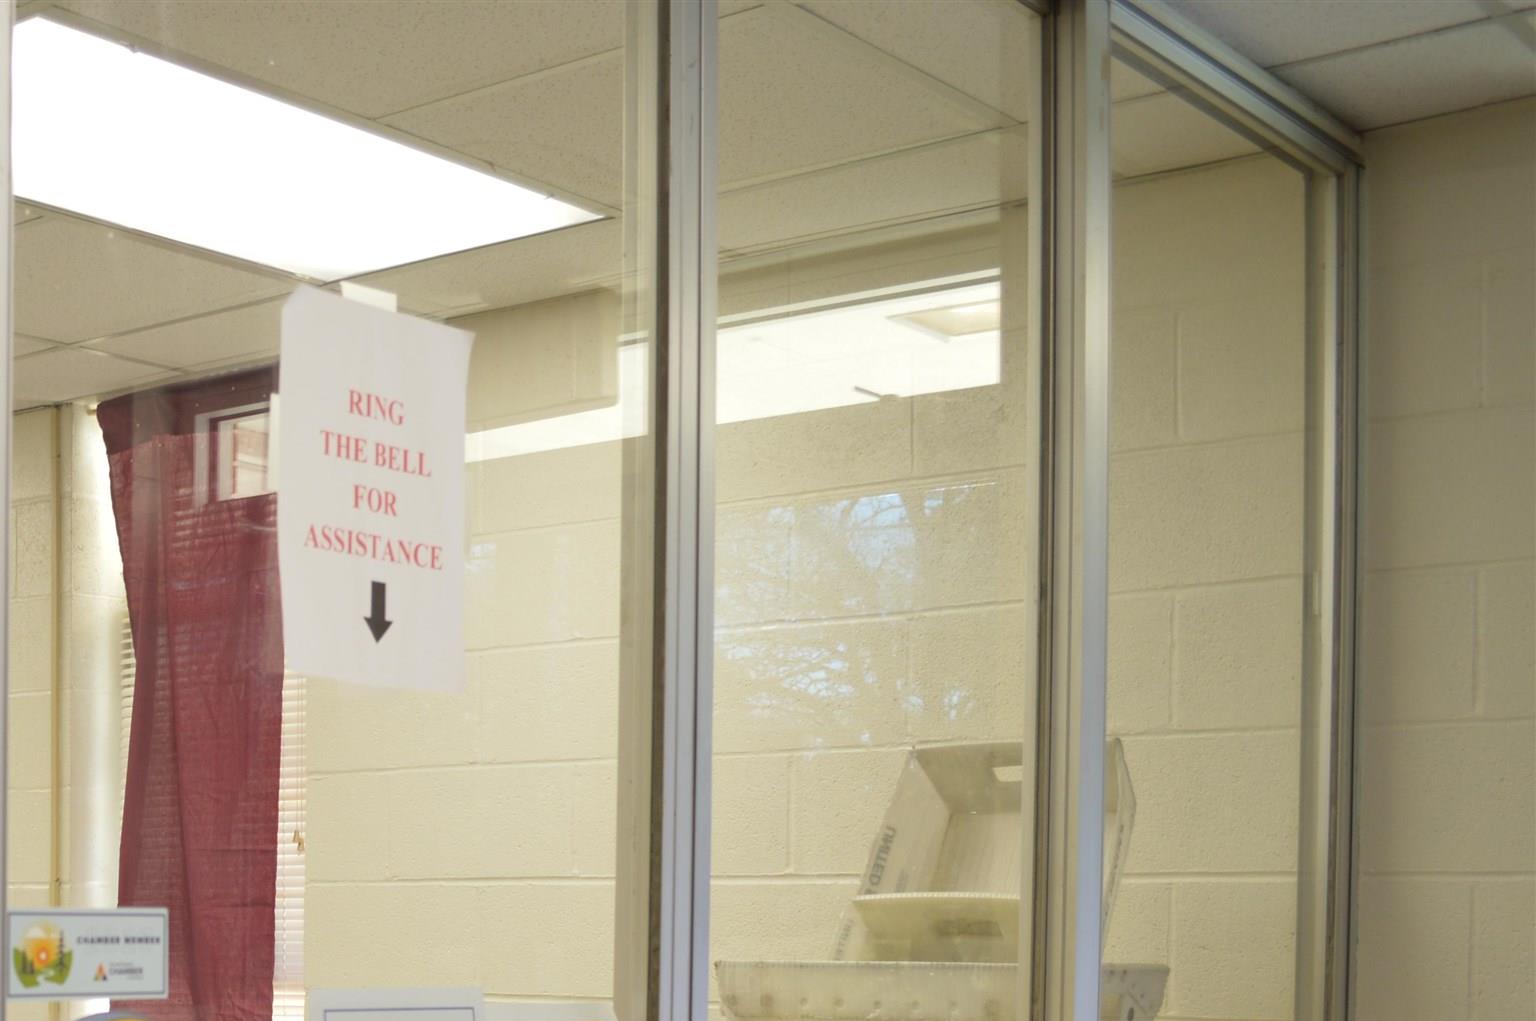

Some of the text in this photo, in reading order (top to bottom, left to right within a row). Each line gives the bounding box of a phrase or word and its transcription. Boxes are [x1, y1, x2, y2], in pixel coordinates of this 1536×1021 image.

[348, 389, 405, 427] RING
[320, 430, 432, 477] THE BELL
[352, 484, 397, 517] FOR
[304, 524, 443, 571] ASSISTANCE
[77, 936, 160, 944] CHAMBER MEMBER
